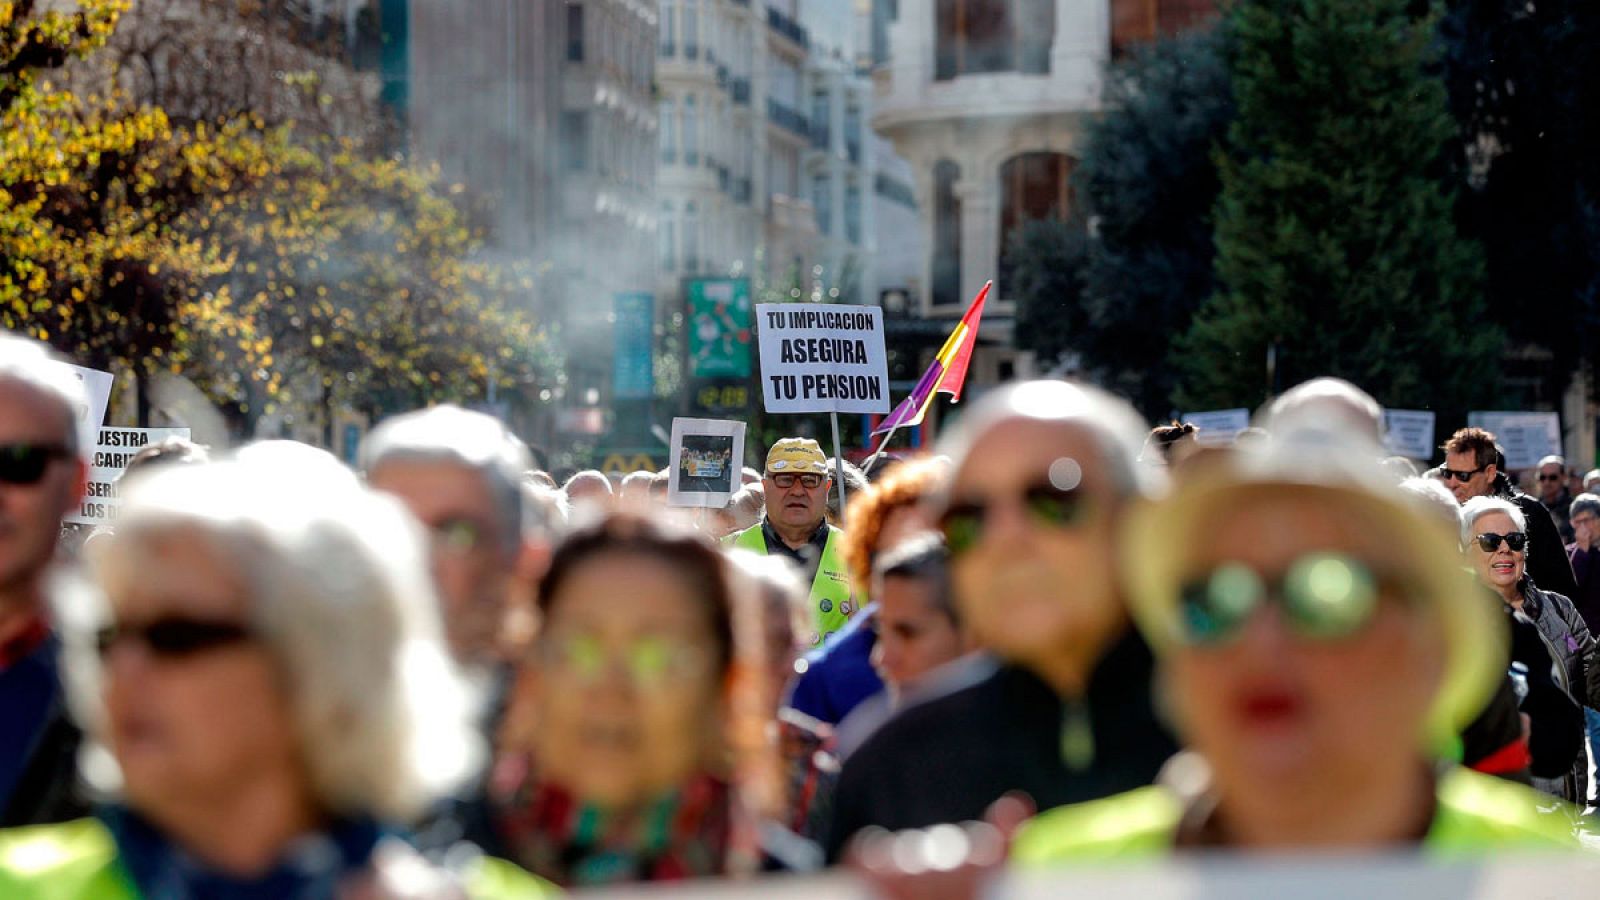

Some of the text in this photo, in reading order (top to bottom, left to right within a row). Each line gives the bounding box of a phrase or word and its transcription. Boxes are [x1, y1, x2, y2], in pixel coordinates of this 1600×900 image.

[766, 311, 786, 329] TU
[780, 338, 868, 364] ASEGURA
[770, 374, 881, 400] TU PENSION
